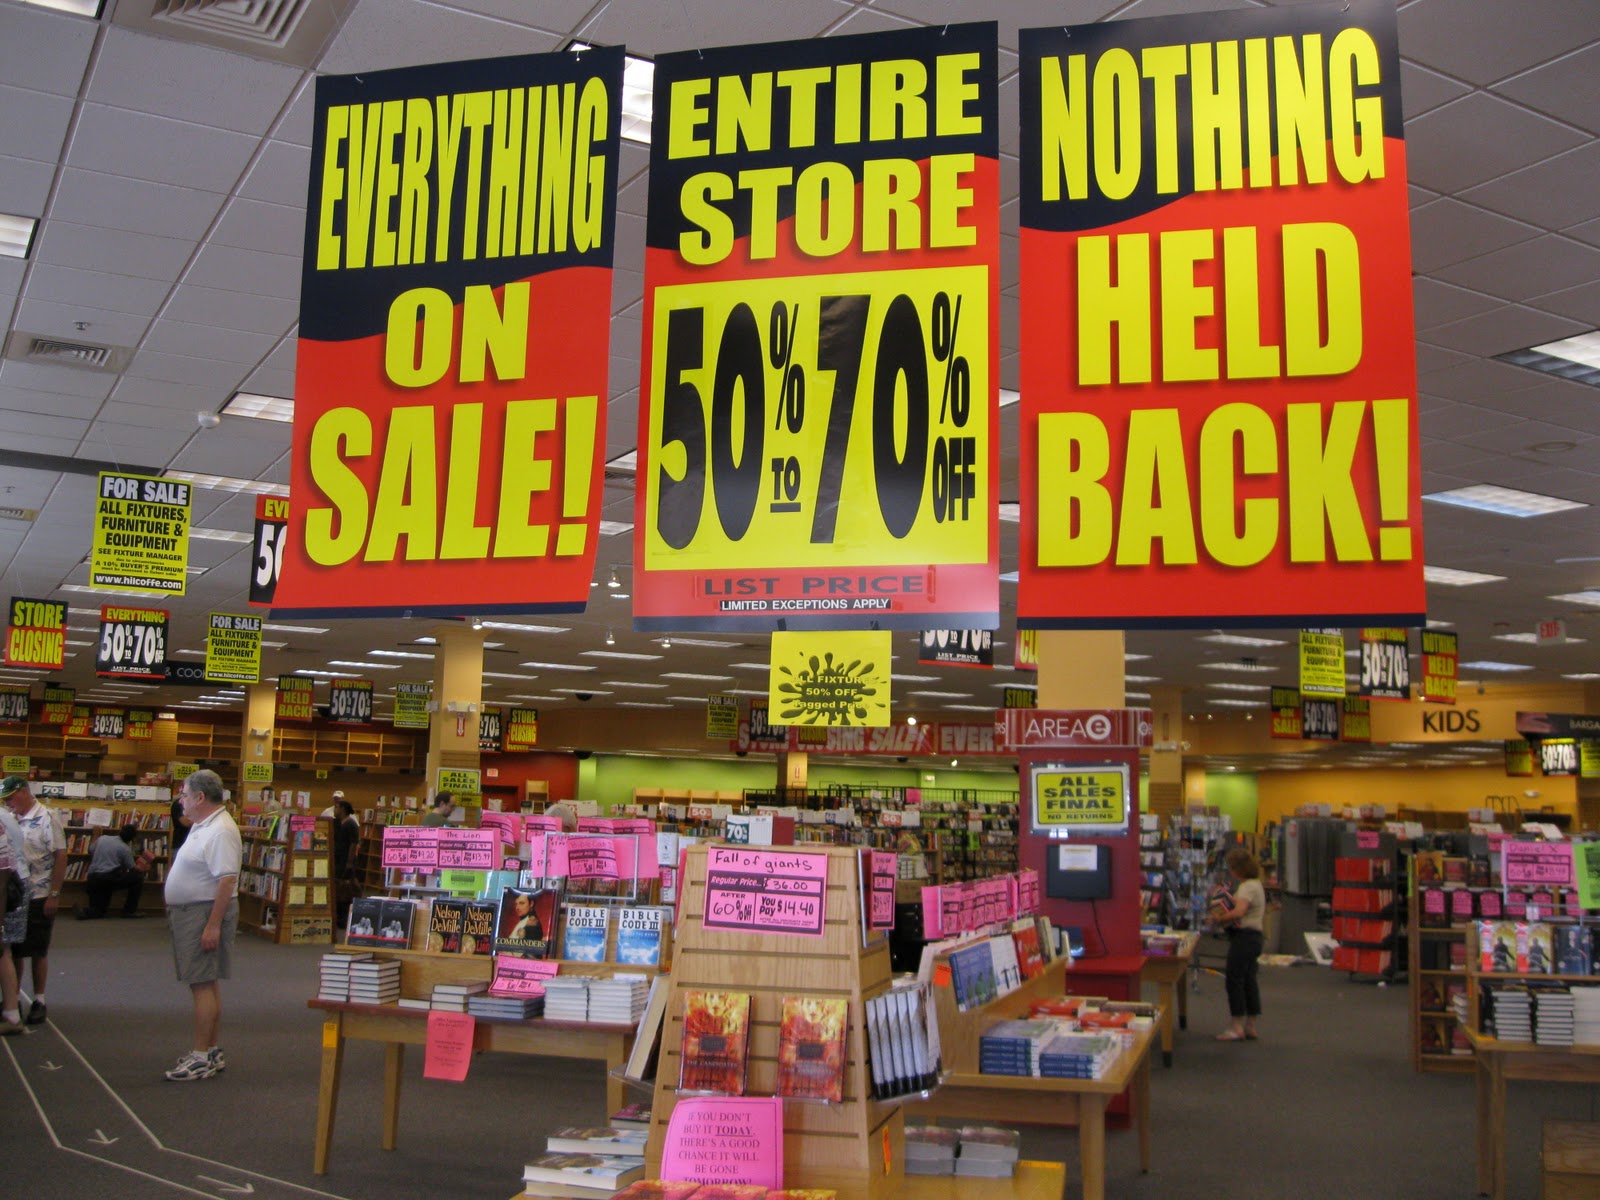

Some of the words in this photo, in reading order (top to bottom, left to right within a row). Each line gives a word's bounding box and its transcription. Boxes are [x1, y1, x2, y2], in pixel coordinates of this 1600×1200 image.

[668, 52, 982, 160] ENTIRE
[1041, 28, 1385, 202] NOTHING
[316, 76, 608, 271] EVERYTHING
[679, 153, 977, 265] STORE
[1078, 222, 1362, 385] HELD
[385, 281, 530, 388] ON
[305, 395, 599, 566] SALE!
[770, 455, 801, 490] TO
[933, 436, 976, 523] OFF
[1038, 398, 1412, 567] BACK!
[103, 476, 139, 500] FOR
[143, 480, 188, 505] SALE
[99, 501, 122, 514] ALL
[126, 503, 187, 523] FIXTURES,
[101, 516, 170, 535] FURNITURE
[173, 523, 183, 537] &
[105, 532, 178, 551] EQUIPMENT
[113, 549, 144, 558] FIXTURE
[146, 552, 182, 561] MANAGER
[120, 562, 149, 570] BUYER'S
[705, 578, 780, 595] LIST
[802, 575, 924, 594] PRICE
[721, 600, 767, 610] LIMITED
[772, 600, 848, 610] EXCEPTIONS
[853, 599, 889, 609] APPLY
[14, 601, 64, 629] STORE
[106, 608, 165, 624] EVERYTHING
[212, 615, 232, 628] FOR
[235, 617, 260, 630] SALE
[210, 629, 222, 637] ALL
[1302, 634, 1313, 644] ALL
[10, 628, 63, 665] CLOSING
[211, 638, 250, 648] FURNITURE
[251, 641, 257, 649] &
[1423, 633, 1457, 653] NOTHING
[213, 648, 254, 658] EQUIPMENT
[1306, 656, 1340, 667] EQUIPMENT
[1428, 656, 1454, 676] HELD
[280, 678, 312, 691] NOTHING
[335, 679, 372, 689] EVERYTHING
[397, 683, 410, 693] FOR
[412, 684, 428, 694] SALE
[806, 687, 830, 696] 50%
[835, 688, 858, 696] OFF
[284, 692, 309, 704] HELD
[710, 695, 721, 705] FOR
[723, 696, 737, 705] SALE
[1006, 689, 1033, 707] STORE
[45, 703, 72, 713] MUST
[512, 709, 536, 723] STORE
[1423, 710, 1480, 733] KIDS
[73, 718, 88, 727] UST
[511, 724, 537, 743] CLOSING
[1059, 776, 1099, 786] ALL
[1044, 787, 1116, 798] SALES
[1046, 799, 1114, 809] FINAL
[716, 850, 739, 863] Fall
[743, 856, 760, 866] of
[711, 875, 738, 886] Regular
[434, 904, 461, 920] Nelson
[466, 906, 492, 921] Nelson
[570, 908, 606, 918] BIBLE
[623, 910, 660, 921] BIBLE
[431, 917, 461, 933] DeMille
[463, 920, 492, 936] DeMille
[569, 917, 593, 928] CODE
[595, 918, 605, 928] III
[622, 919, 647, 929] CODE
[649, 921, 659, 930] III
[444, 938, 459, 949] Lion
[476, 940, 491, 951] Lion
[495, 937, 546, 948] COMMANDERS
[688, 1112, 697, 1121] IF
[698, 1112, 717, 1121] YOU
[719, 1112, 752, 1121] DON'T
[683, 1125, 702, 1134] BUY
[703, 1125, 712, 1134] IT
[679, 1138, 717, 1147] THERE'S
[719, 1139, 727, 1147] A
[729, 1139, 760, 1148] GOOD
[678, 1151, 717, 1160] CHANCE
[720, 1152, 730, 1160] IT
[732, 1152, 760, 1161] WILL
[694, 1164, 706, 1173] BE
[709, 1165, 739, 1174] GONE
